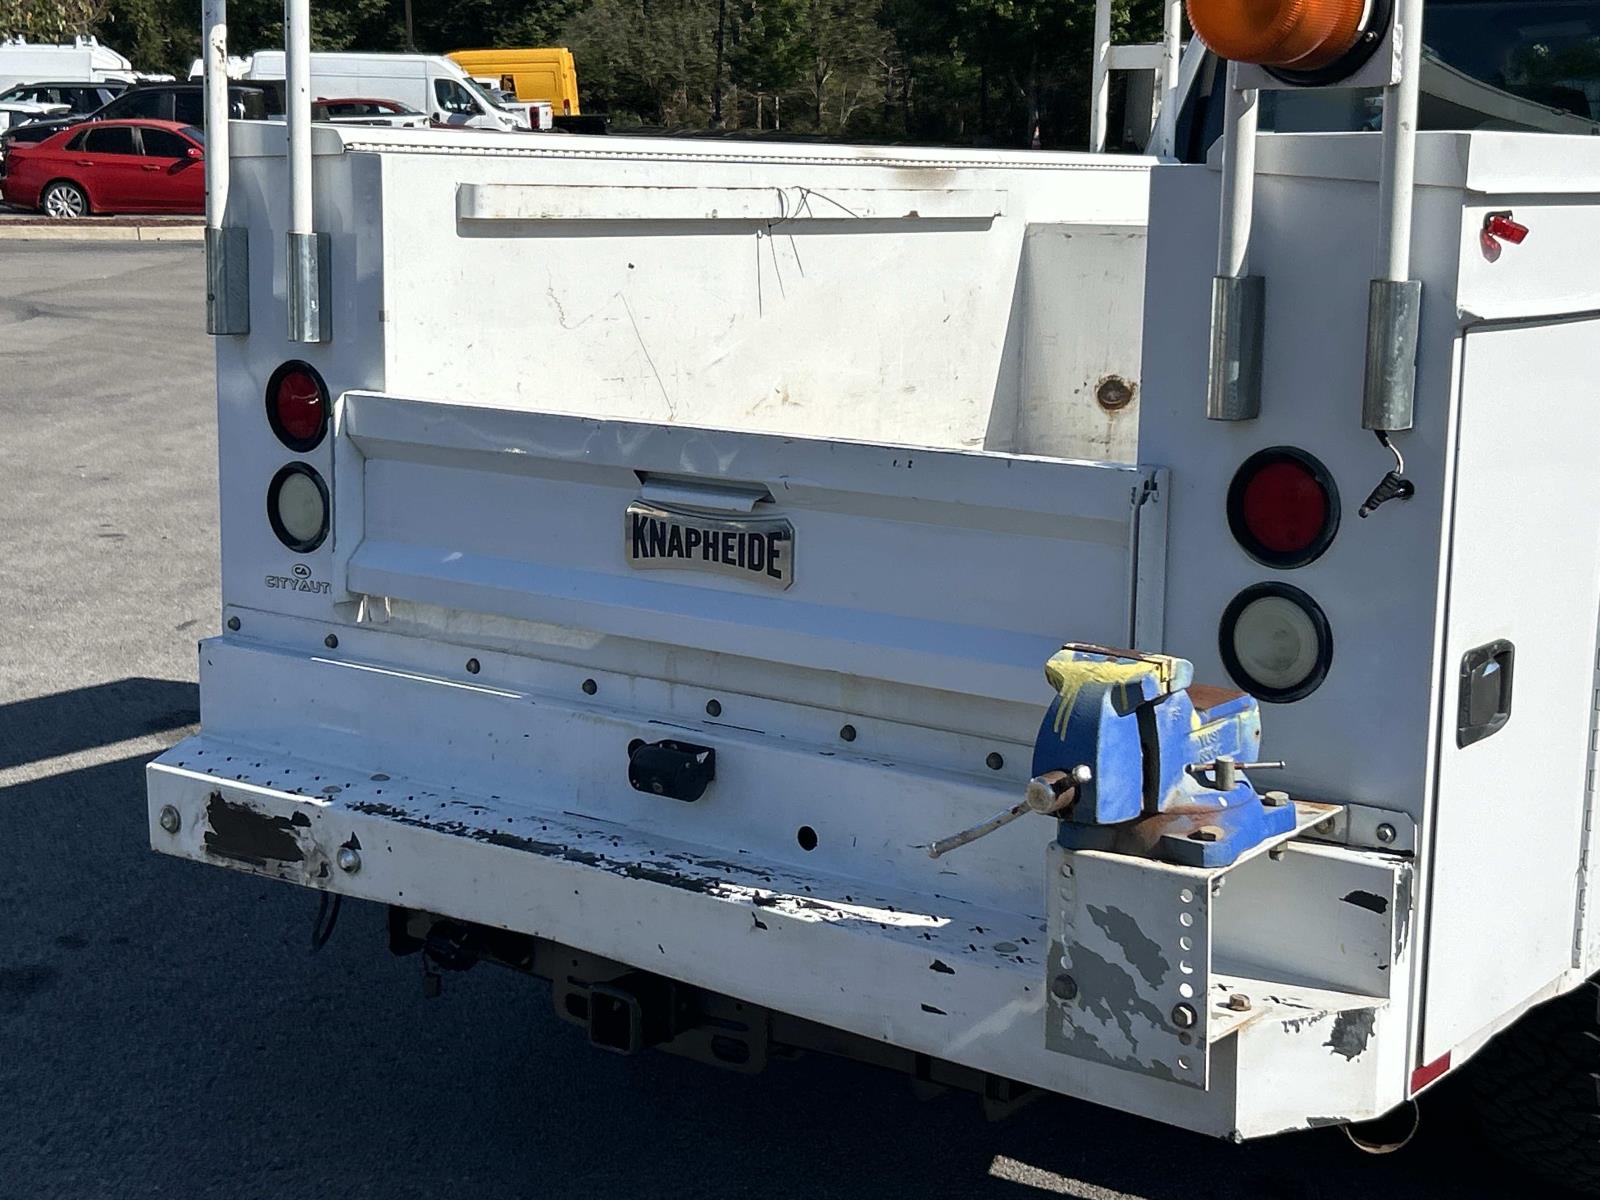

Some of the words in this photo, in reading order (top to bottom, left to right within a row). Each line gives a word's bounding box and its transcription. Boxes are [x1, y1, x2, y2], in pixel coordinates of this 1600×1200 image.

[632, 513, 782, 579] KNAPHEIDE
[294, 567, 307, 576] CA
[265, 576, 332, 594] CITYAUT
